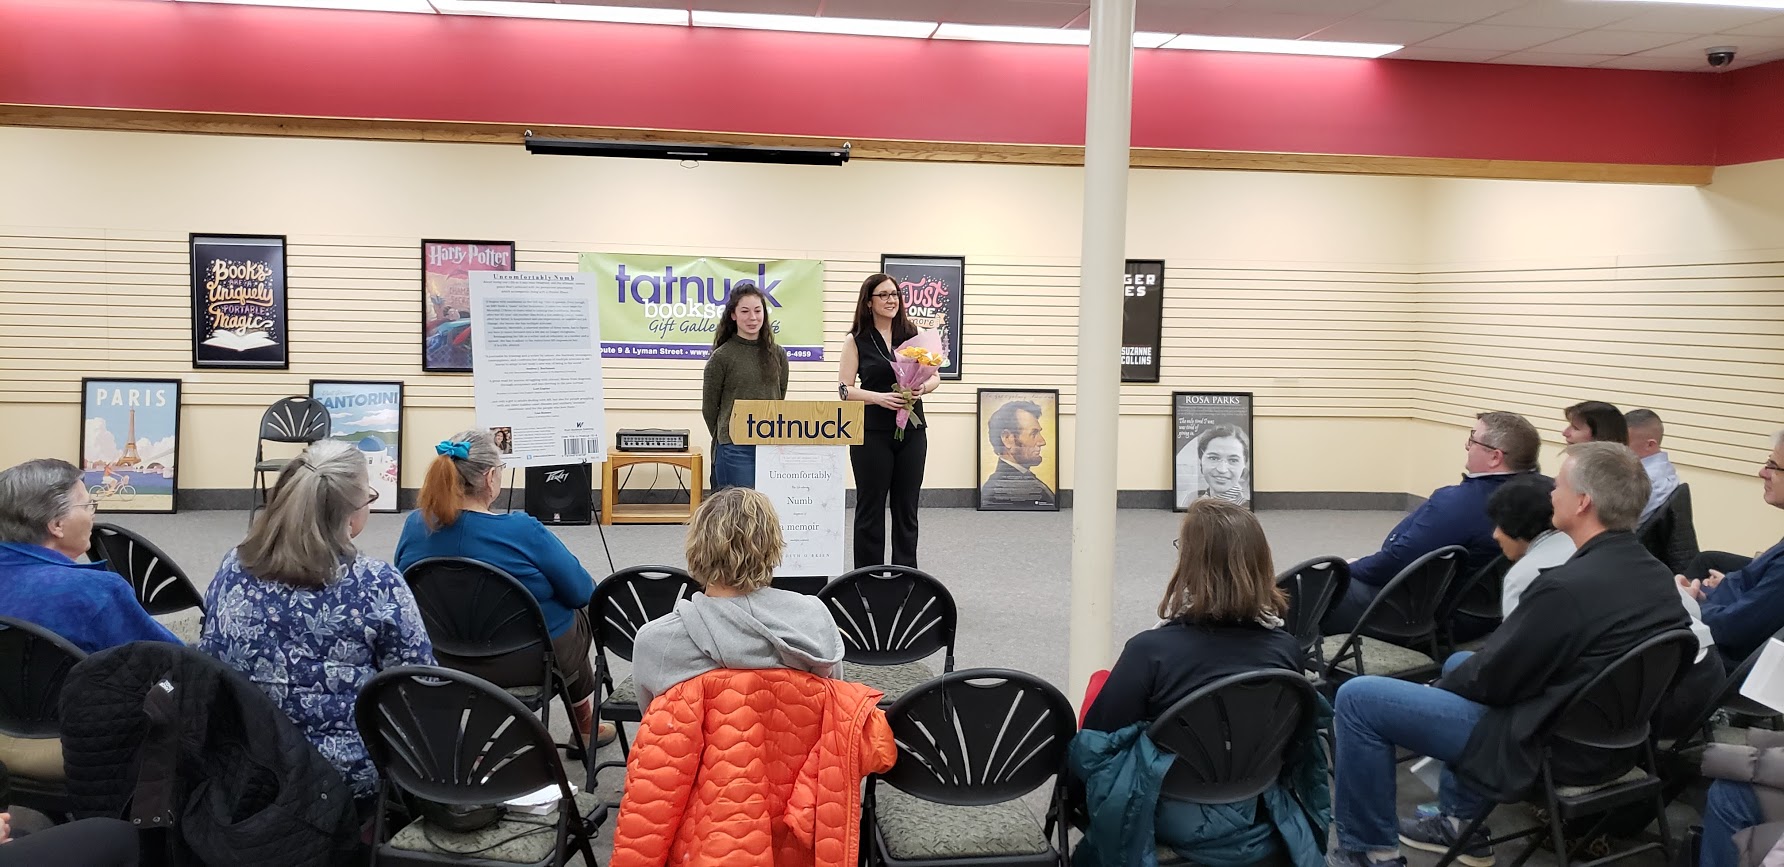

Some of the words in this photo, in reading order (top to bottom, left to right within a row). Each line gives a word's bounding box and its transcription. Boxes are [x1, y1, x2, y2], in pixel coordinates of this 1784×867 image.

[429, 245, 467, 266] Harry
[468, 244, 509, 267] Potter
[208, 259, 273, 286] Books
[493, 273, 551, 282] Uncomfortably
[1124, 274, 1156, 285] GER
[209, 283, 273, 306] Uniquely
[899, 278, 949, 308] Just
[224, 304, 267, 315] PORTABLE
[908, 306, 936, 317] ONE
[210, 310, 273, 336] Magic
[649, 319, 676, 339] Gift
[679, 317, 716, 333] Galle
[632, 347, 658, 356] Lyman
[659, 348, 684, 356] Street
[689, 350, 711, 358] www.
[786, 350, 812, 358] 6-4959
[1121, 346, 1152, 356] SUZANNE
[1120, 356, 1152, 365] COLLINS
[96, 388, 167, 408] PARIS
[316, 392, 398, 409] ANTORINI
[1185, 395, 1210, 404] ROSA
[1212, 396, 1240, 405] PARKS
[746, 407, 852, 439] tatnuck
[769, 470, 832, 482] Uncomfortably
[787, 496, 813, 505] Numb
[787, 521, 820, 531] memoir
